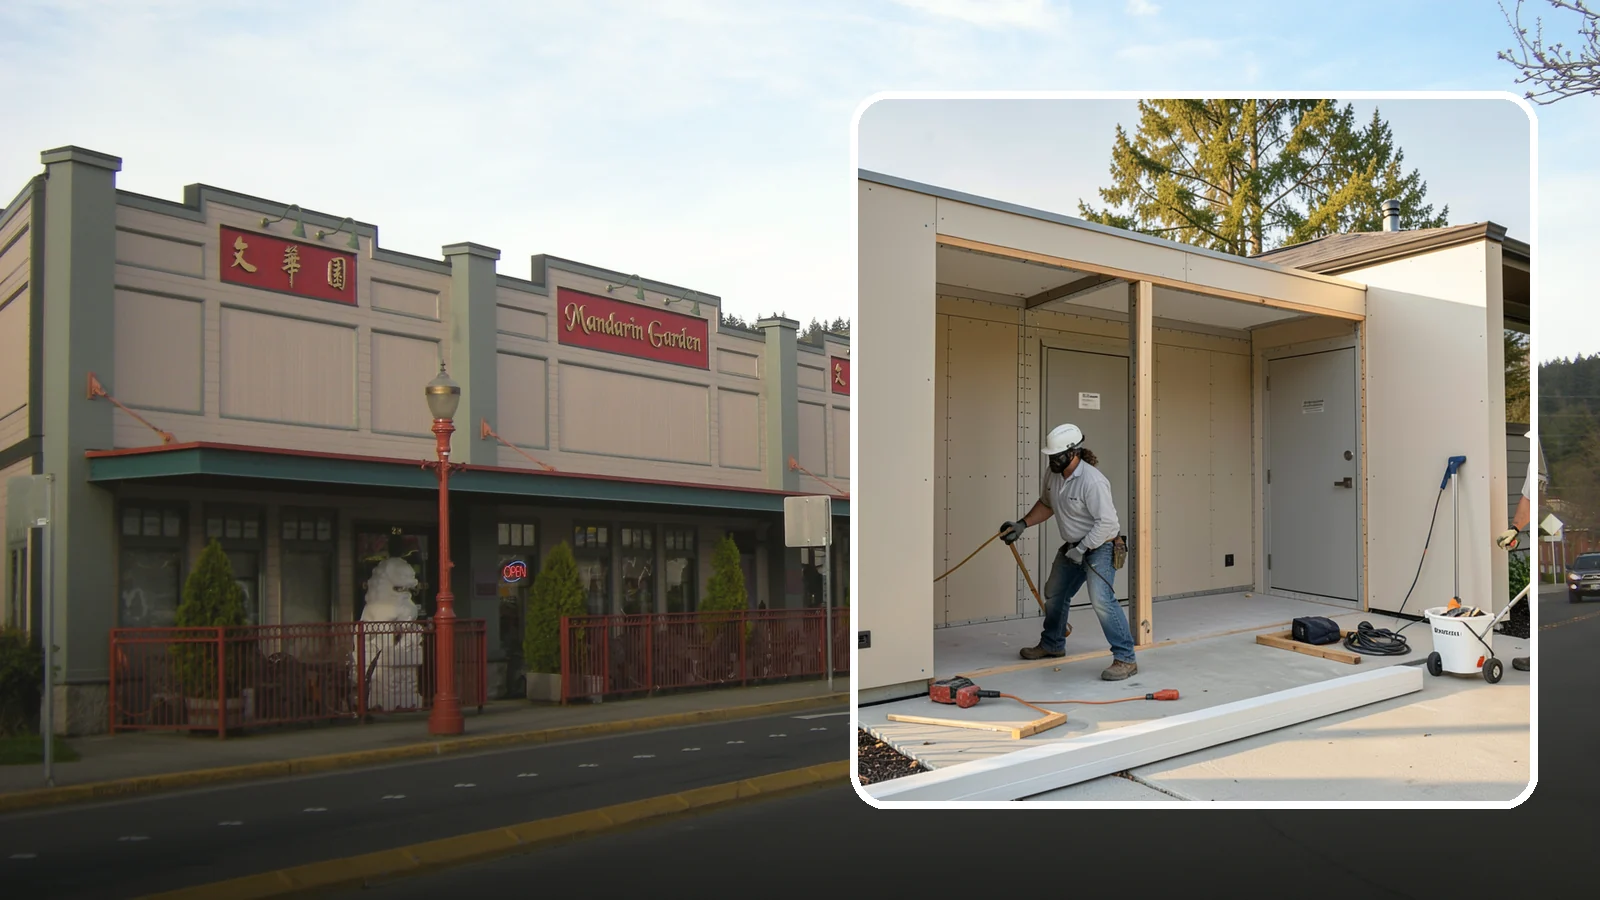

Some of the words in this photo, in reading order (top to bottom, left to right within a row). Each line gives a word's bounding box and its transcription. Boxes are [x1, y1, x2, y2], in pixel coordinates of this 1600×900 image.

[230, 235, 346, 291] 文華園
[564, 302, 644, 341] Mandarin
[648, 320, 701, 352] Garden
[503, 565, 527, 578] OPEN
